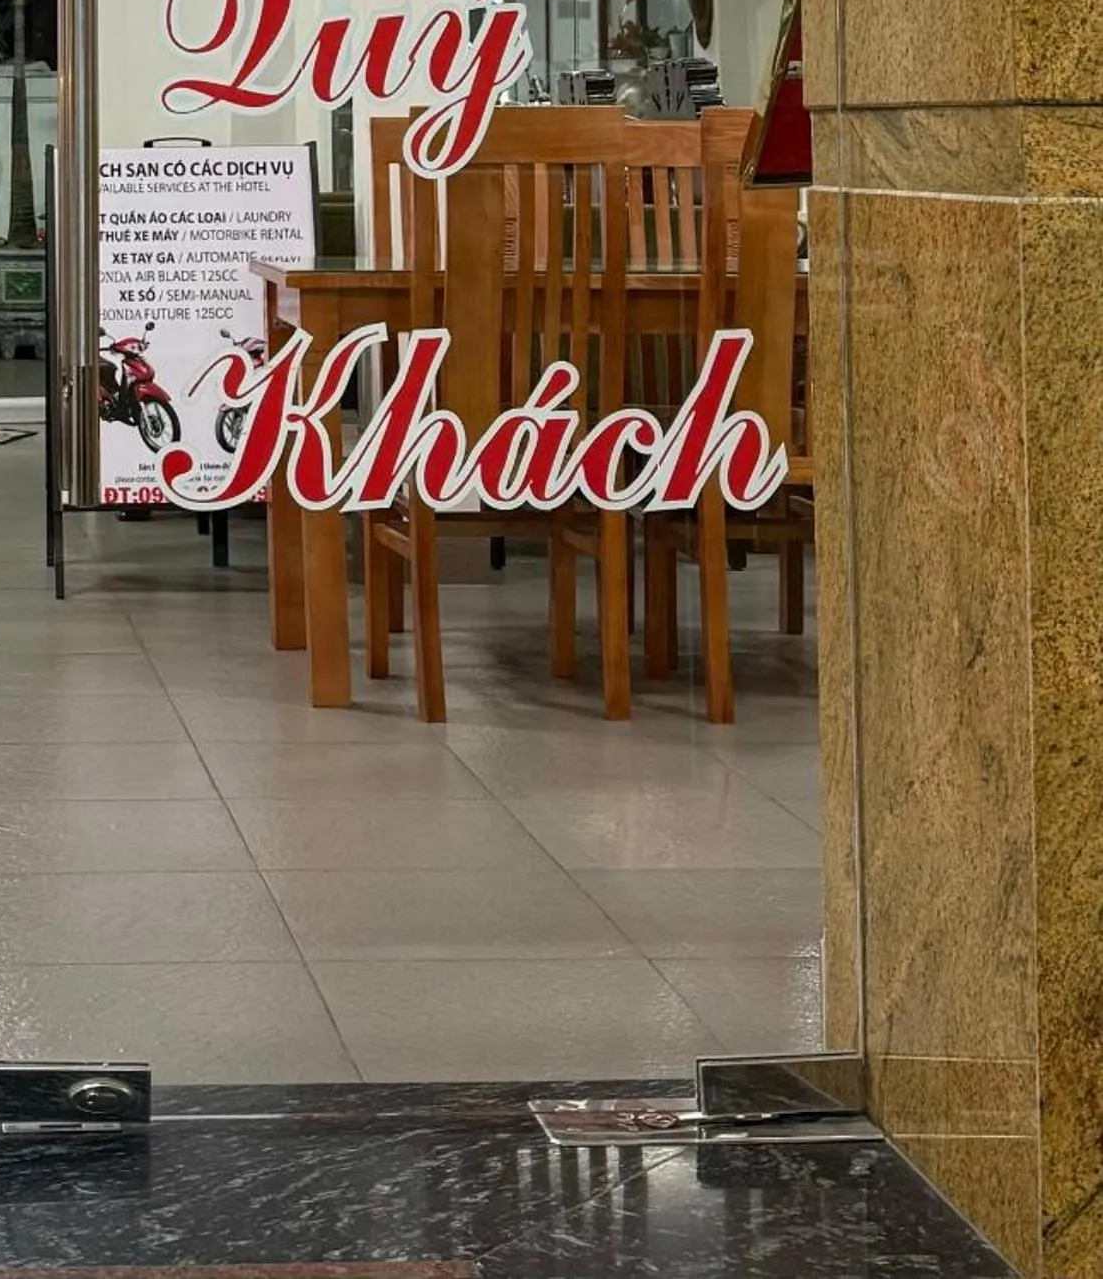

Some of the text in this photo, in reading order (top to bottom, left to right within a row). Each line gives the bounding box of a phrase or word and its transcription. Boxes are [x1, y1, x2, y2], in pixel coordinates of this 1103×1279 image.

[126, 163, 159, 181] SẠN
[163, 160, 186, 177] CÓ
[190, 159, 223, 176] CÁC
[227, 161, 267, 179] DỊCH
[270, 161, 294, 179] VỤ
[147, 182, 196, 193] SERVICES
[198, 181, 210, 192] AT
[212, 181, 234, 192] THE
[236, 181, 271, 192] HOTEL
[170, 210, 195, 223] CÁC
[237, 211, 292, 223] LAUNDRY
[134, 230, 149, 241] XE
[152, 228, 178, 242] MÁY
[189, 229, 257, 241] MOTORBIKE
[260, 228, 304, 240] RENTAL
[112, 253, 128, 264] XE
[130, 253, 153, 264] TAY
[156, 252, 175, 264] GA
[135, 270, 155, 282] AIR
[158, 270, 197, 282] BLADE
[201, 269, 239, 282] 125CC
[119, 290, 135, 302] XE
[166, 289, 254, 301] SEMI-MANUAL
[144, 308, 191, 320] FUTURE
[195, 307, 234, 319] 125CC
[160, 322, 789, 514] Khách
